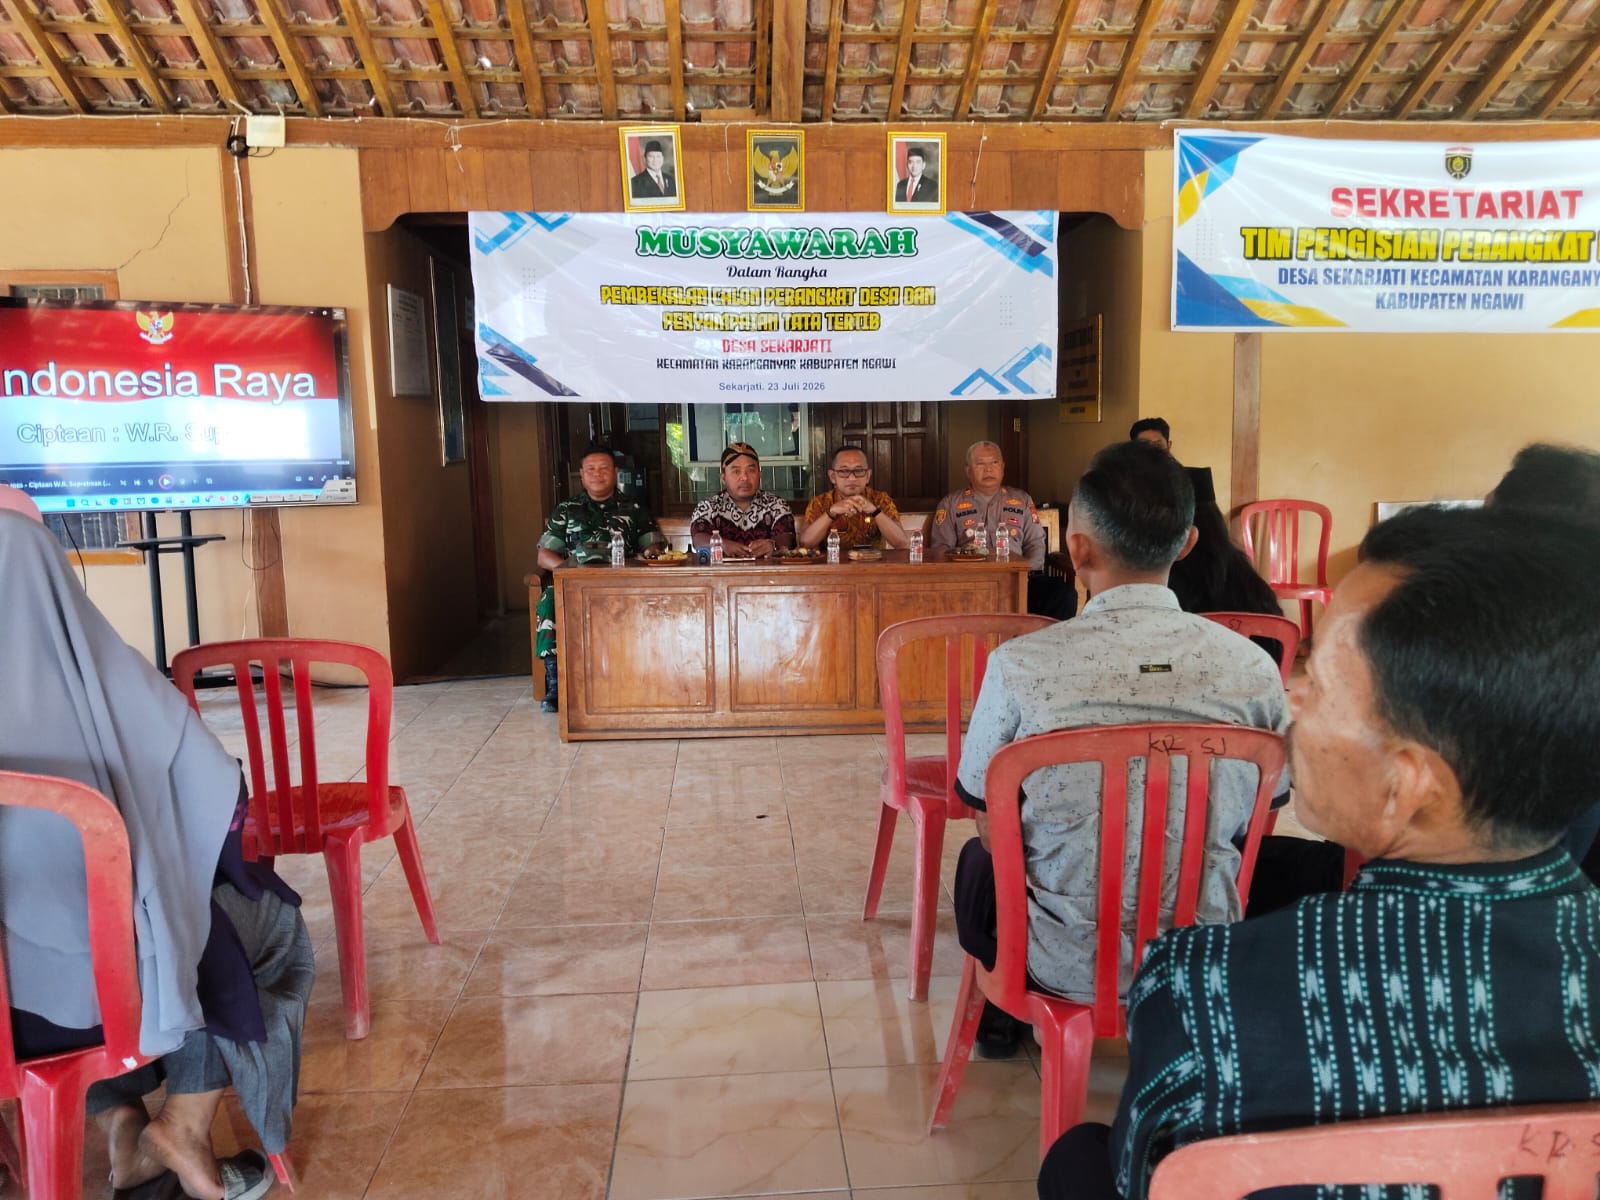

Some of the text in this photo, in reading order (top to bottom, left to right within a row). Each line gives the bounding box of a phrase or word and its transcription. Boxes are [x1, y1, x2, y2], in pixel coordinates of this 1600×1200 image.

[1331, 187, 1583, 219] SEKRETARIAT
[636, 226, 918, 259] MUSYAWARAH
[1240, 226, 1293, 260] TIM
[1296, 226, 1440, 262] PENGISIAN
[1442, 228, 1596, 263] PERANGKAT
[726, 264, 827, 281] Dalam Rangka
[1278, 267, 1600, 287] DESA SEKARJATI KECAMATAN KARANGANY
[600, 285, 936, 306] PEMBEKALAN CALON PERANGKAT DESA DAN
[1375, 292, 1524, 310] KABUPATEN NGAWI
[662, 311, 881, 331] PENYAMPAIAN TATA TERTIB
[721, 338, 832, 353] DESA SEKARJATI
[657, 358, 897, 370] KECAMATAN KARANGANYAR KABUPATEN NGAWI
[213, 363, 316, 405] Raya
[768, 382, 779, 391] 23
[782, 382, 800, 391] Juli
[802, 382, 825, 391] 2026
[17, 424, 106, 447] Ciptaan
[125, 423, 178, 442] W.R.
